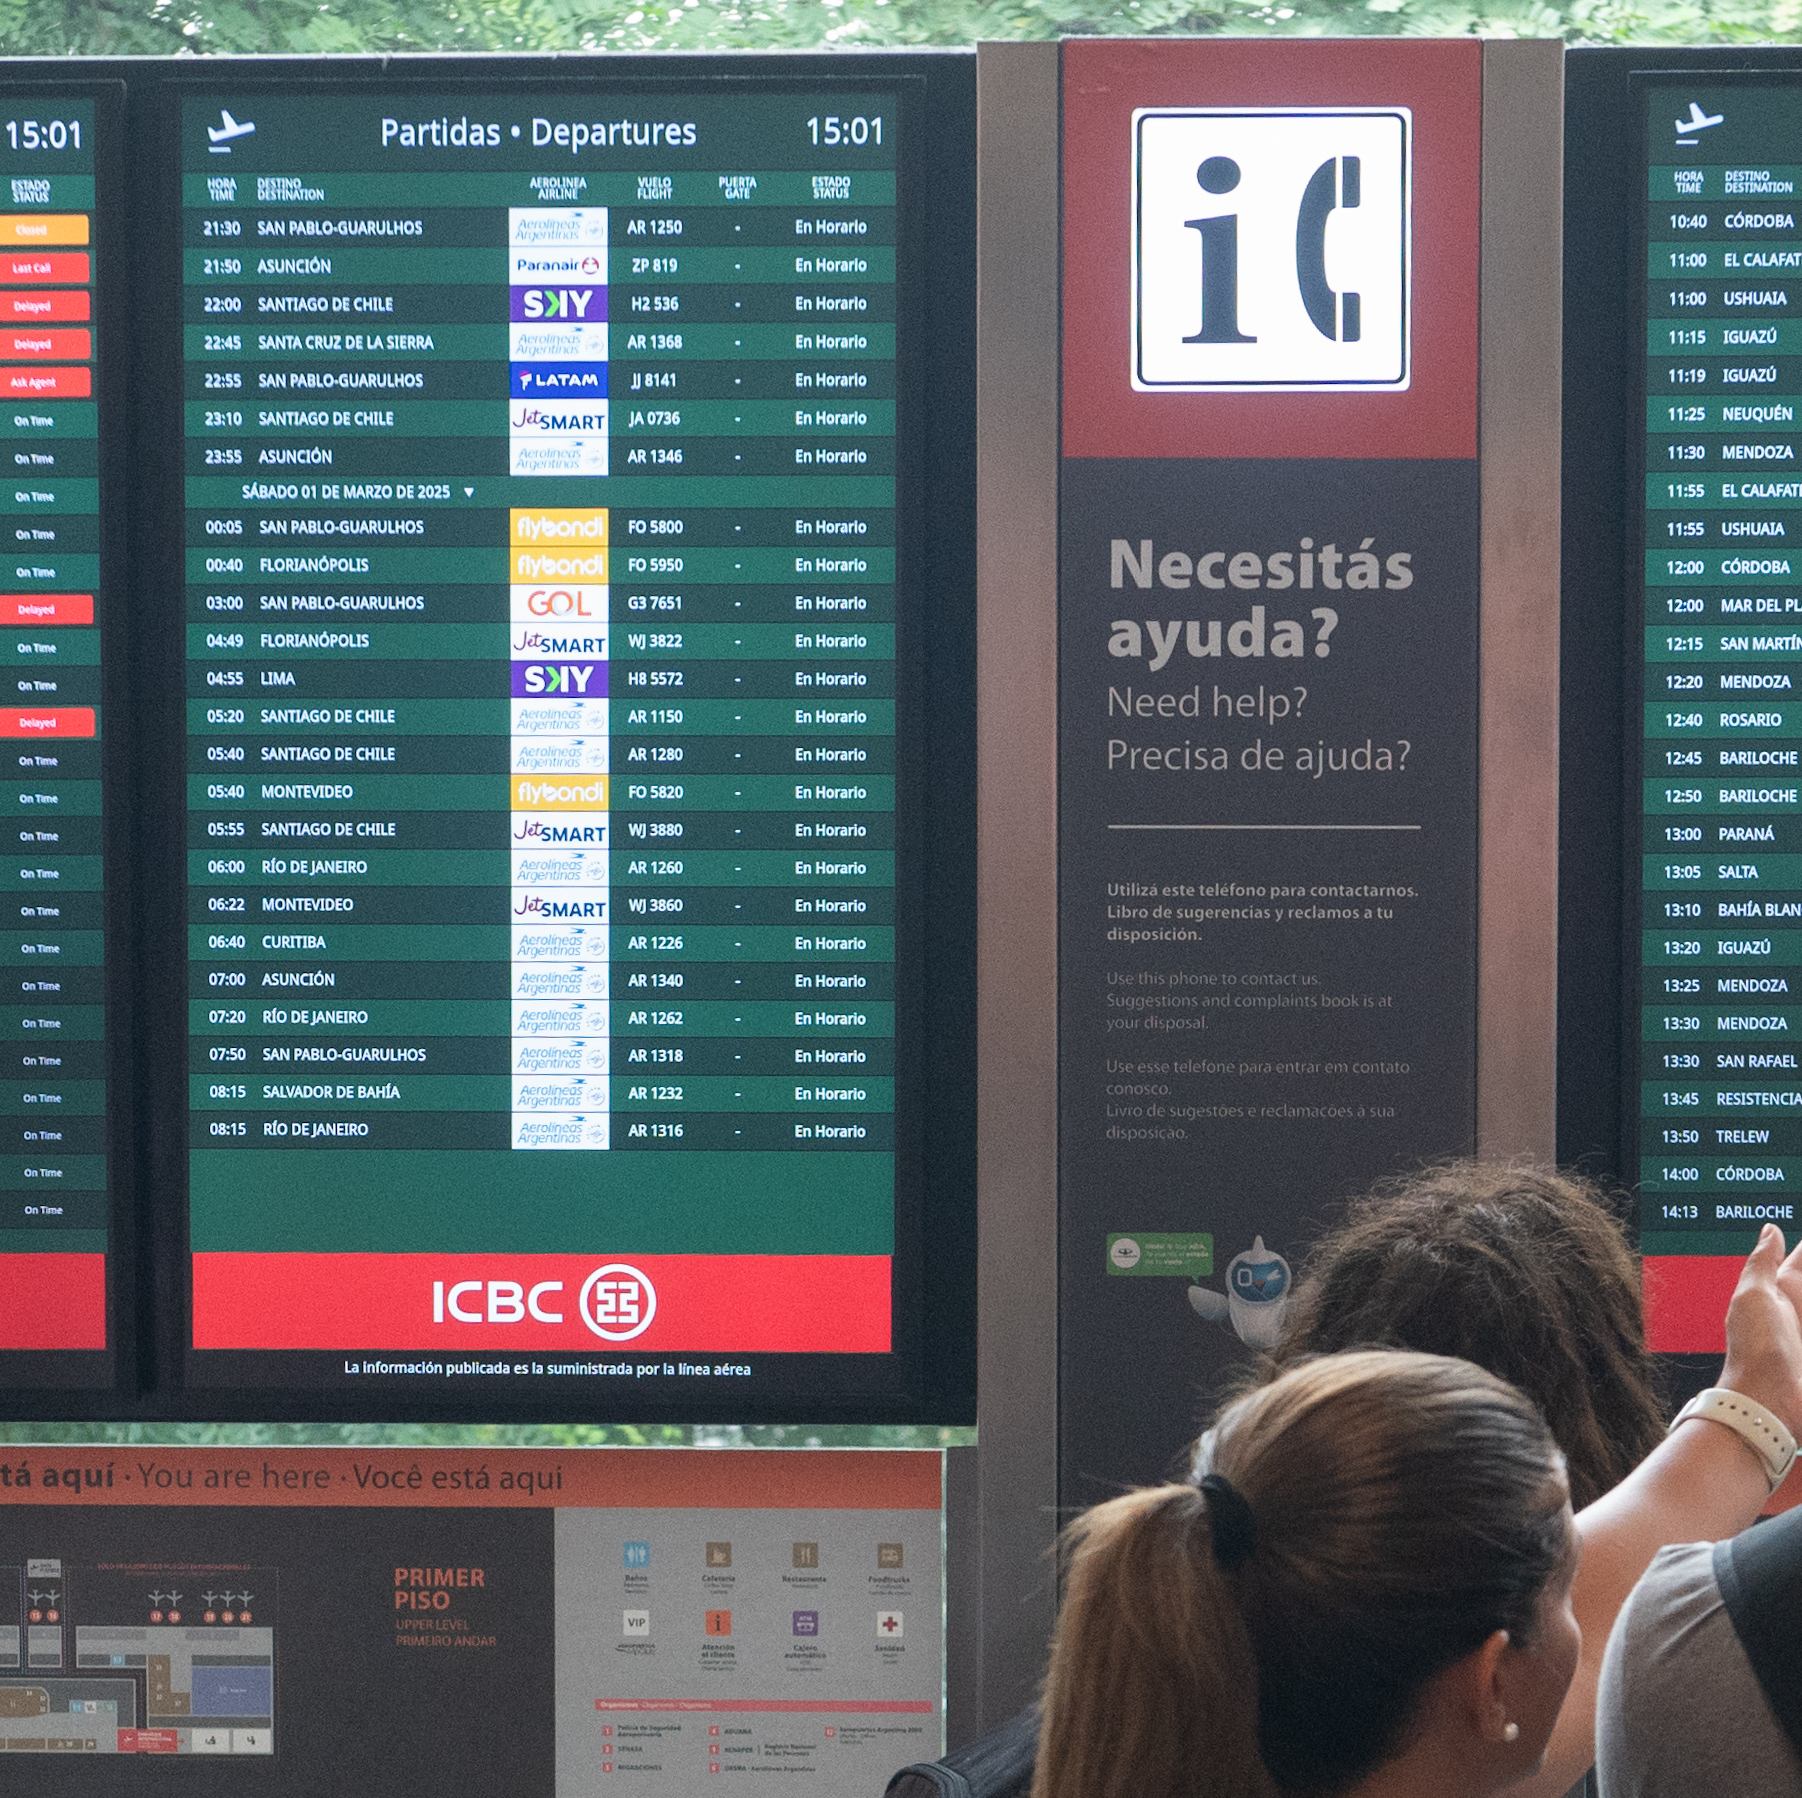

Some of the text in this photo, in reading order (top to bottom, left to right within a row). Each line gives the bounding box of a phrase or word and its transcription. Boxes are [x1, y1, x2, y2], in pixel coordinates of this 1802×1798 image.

[6, 120, 81, 150] 15:01
[382, 116, 882, 154] Partidas Departures 15:01
[1670, 214, 1708, 229] 10:40
[1724, 211, 1795, 229] CÓRDOBA
[1669, 252, 1708, 268] 11:00
[1724, 252, 1741, 267] EL
[204, 297, 242, 312] 22:00
[257, 296, 327, 312] SANTIAGO
[330, 296, 350, 312] DE
[353, 296, 393, 312] CHILE
[631, 296, 651, 312] H2
[654, 296, 679, 311] 536
[795, 295, 813, 311] En
[815, 296, 867, 311] Horario
[242, 481, 451, 500] SÁBADO 01 DE MARZO DE 2025
[1110, 536, 1414, 590] Necesitás
[1107, 605, 1339, 672] ayuda?
[1108, 684, 1308, 726] Need help?
[1108, 738, 1411, 780] Precisa de ajuda?
[1107, 882, 1419, 900] Utilizá este teléfono para contactarnos.
[208, 895, 867, 918] 06:22 MONTEVIDEO JetSMART WJ 3860 En Horario
[1107, 904, 1393, 923] Libro de sugerencias y reclamos a tu
[1106, 926, 1203, 944] disposición.
[1662, 1129, 1770, 1144] 13:50 TRELEW
[24, 1205, 39, 1215] On
[39, 1205, 64, 1215] Time
[433, 1280, 563, 1323] ICBC
[42, 1461, 116, 1494] aquí
[141, 1464, 194, 1490] You
[204, 1468, 252, 1489] are
[262, 1460, 331, 1490] here
[352, 1462, 423, 1490] Você
[431, 1463, 490, 1490] está
[499, 1464, 562, 1497] aqui
[394, 1567, 485, 1587] PRIMER
[395, 1590, 450, 1610] PISO
[395, 1618, 469, 1632] UPPER LEVEL
[627, 1617, 646, 1628] VIP
[396, 1634, 497, 1647] PRIMEIRO ANDAR
